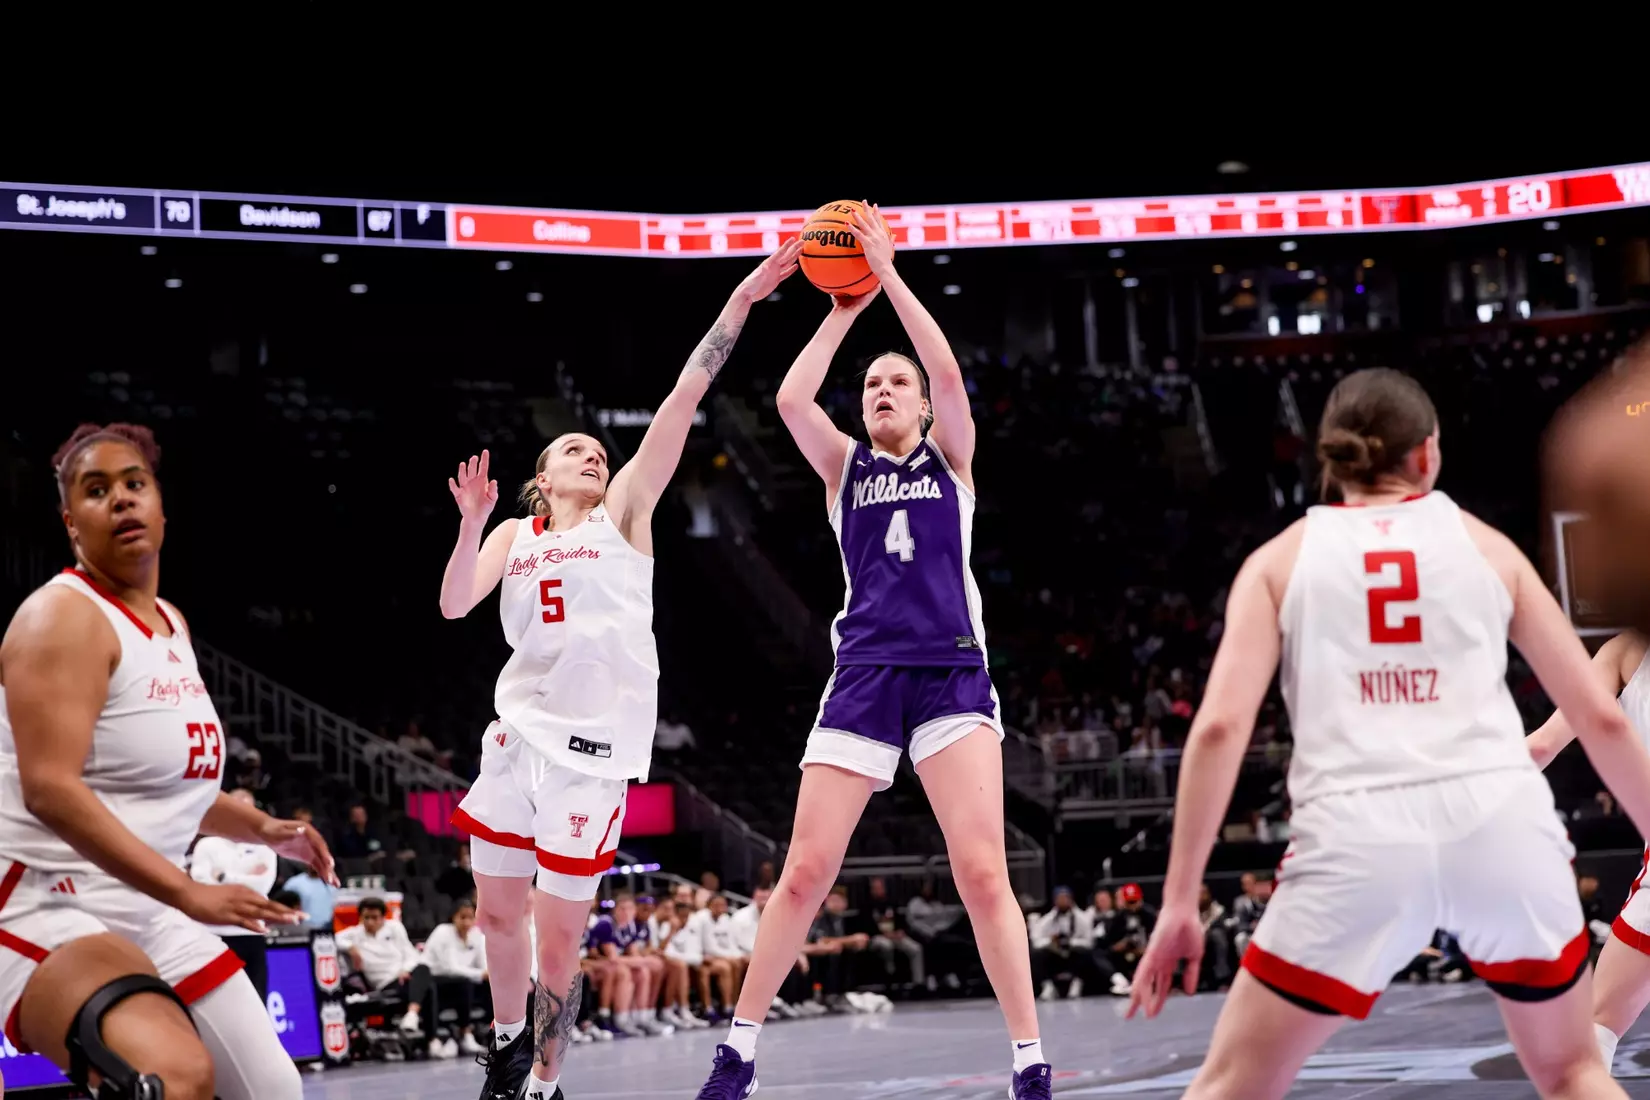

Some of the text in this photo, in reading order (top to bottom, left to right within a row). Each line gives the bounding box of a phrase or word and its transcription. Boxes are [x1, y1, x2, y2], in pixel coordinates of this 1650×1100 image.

[240, 204, 320, 228] Davidson
[1508, 181, 1552, 214] 20
[802, 230, 856, 248] Wilson
[852, 472, 943, 511] Wildcats
[884, 508, 915, 562] 4
[507, 545, 601, 577] Lady Raiders
[539, 579, 565, 623] 5
[1364, 551, 1422, 643] 2
[146, 677, 181, 706] Lady
[1360, 661, 1440, 705] NÚÑEZ
[182, 722, 221, 780] 23
